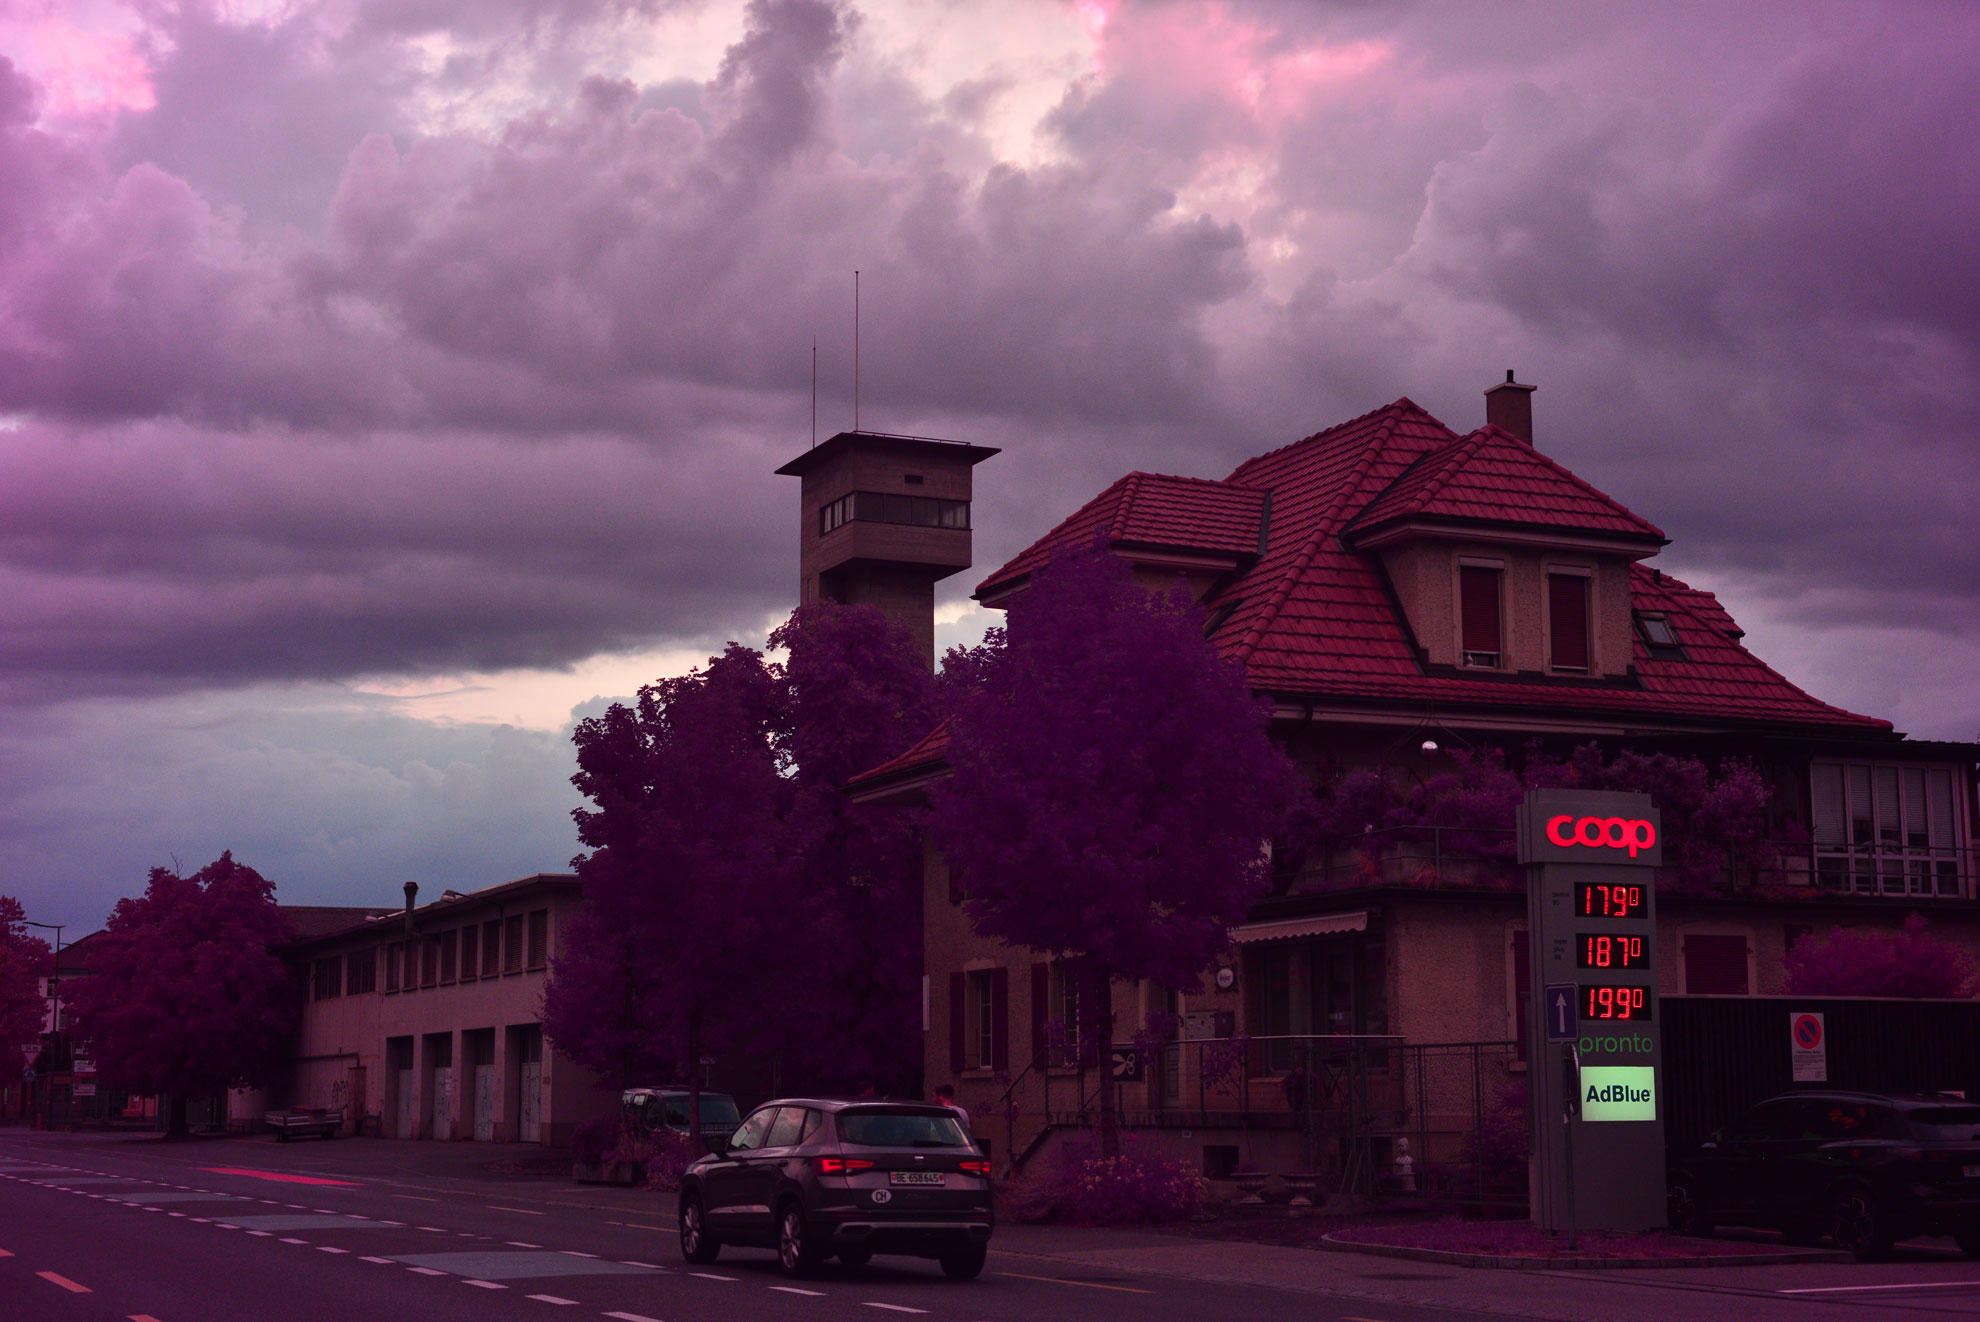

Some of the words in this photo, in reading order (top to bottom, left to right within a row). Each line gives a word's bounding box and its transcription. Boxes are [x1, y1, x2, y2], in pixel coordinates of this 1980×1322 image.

[1546, 814, 1656, 859] coop
[1579, 1032, 1653, 1056] pronto
[1586, 1085, 1651, 1102] AdBlue
[875, 1191, 887, 1202] CH
